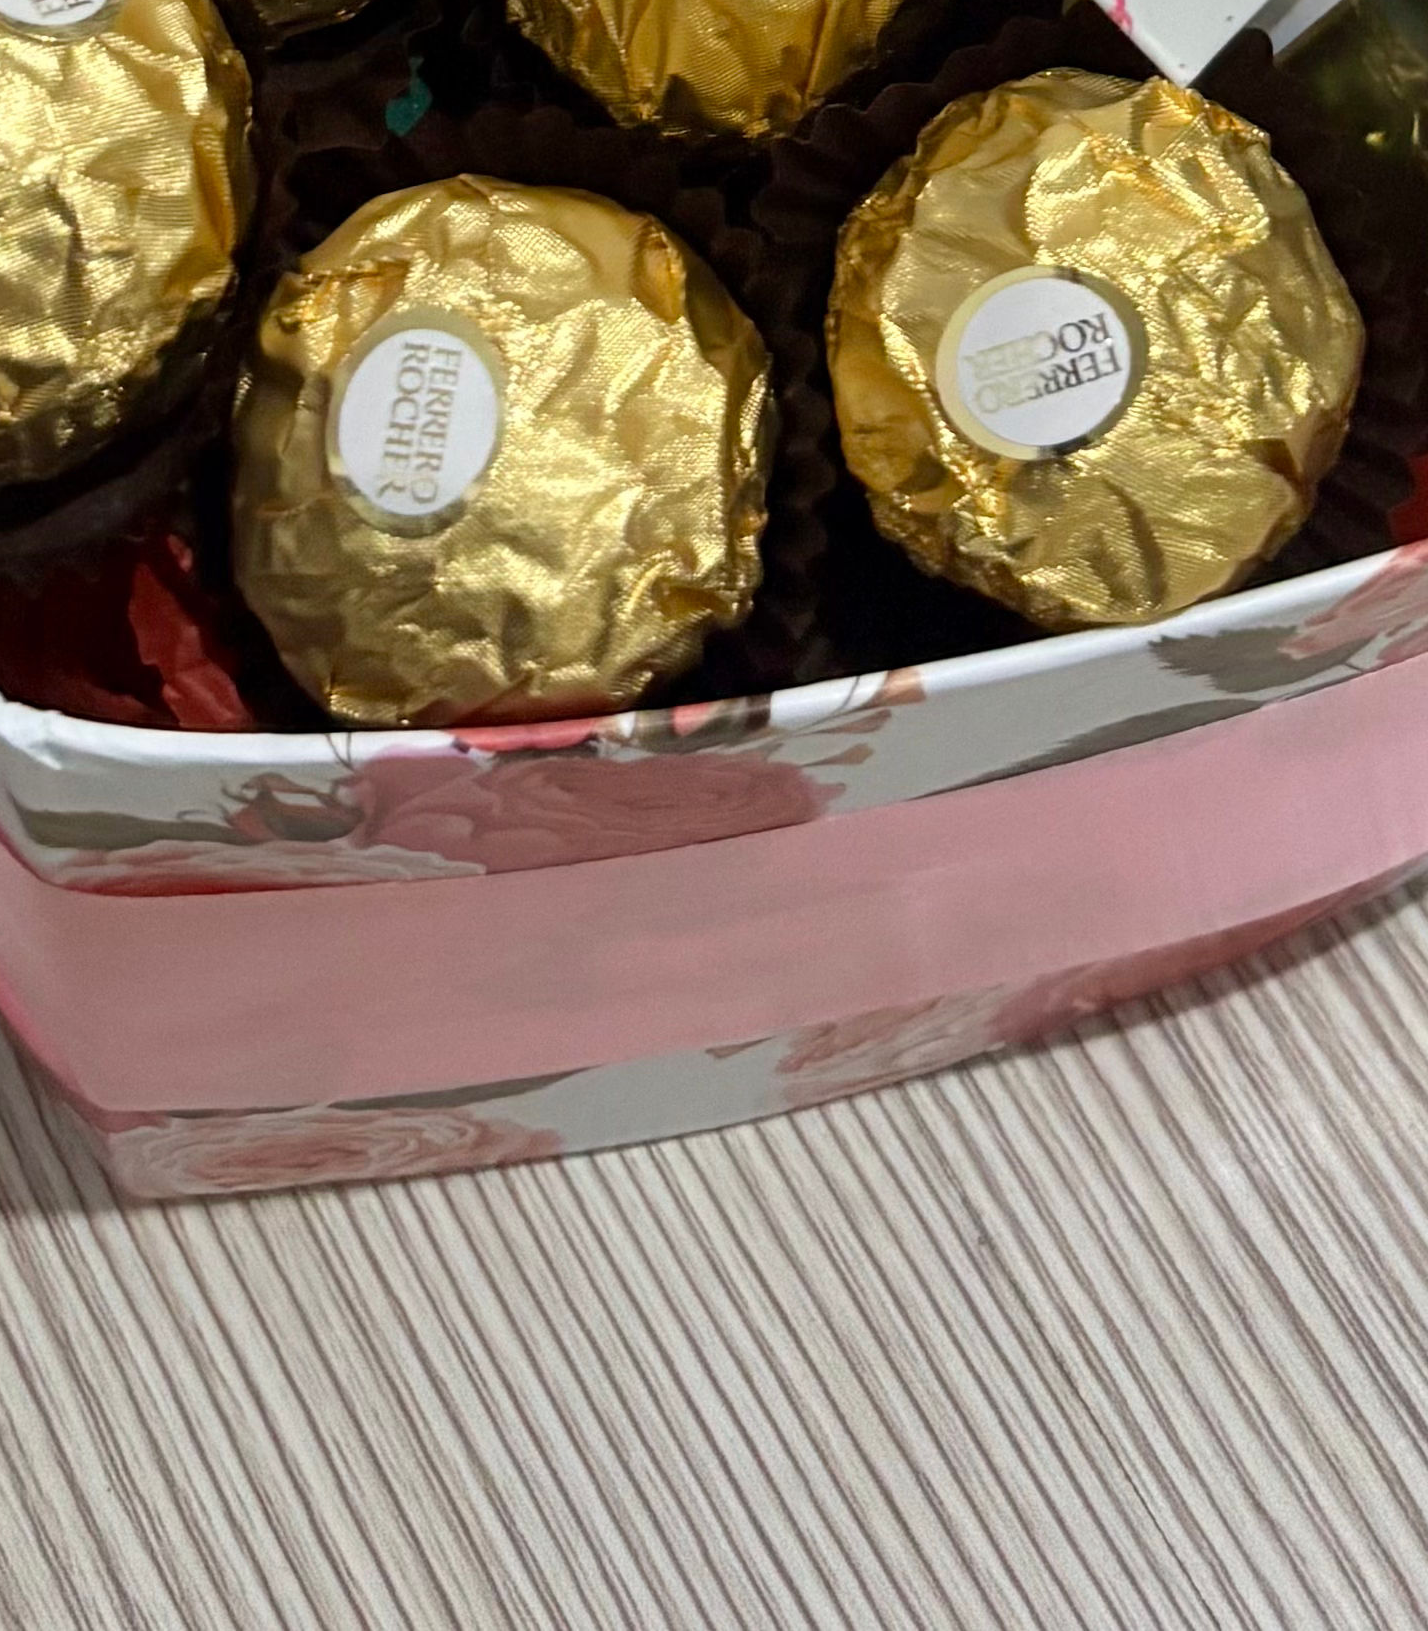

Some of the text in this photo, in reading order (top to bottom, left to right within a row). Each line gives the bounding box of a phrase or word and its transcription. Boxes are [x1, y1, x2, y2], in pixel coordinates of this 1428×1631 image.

[962, 311, 1111, 380] ROCHER
[976, 346, 1122, 413] FERRERO
[376, 342, 431, 499] ROCHER
[410, 347, 462, 505] FERRERO
